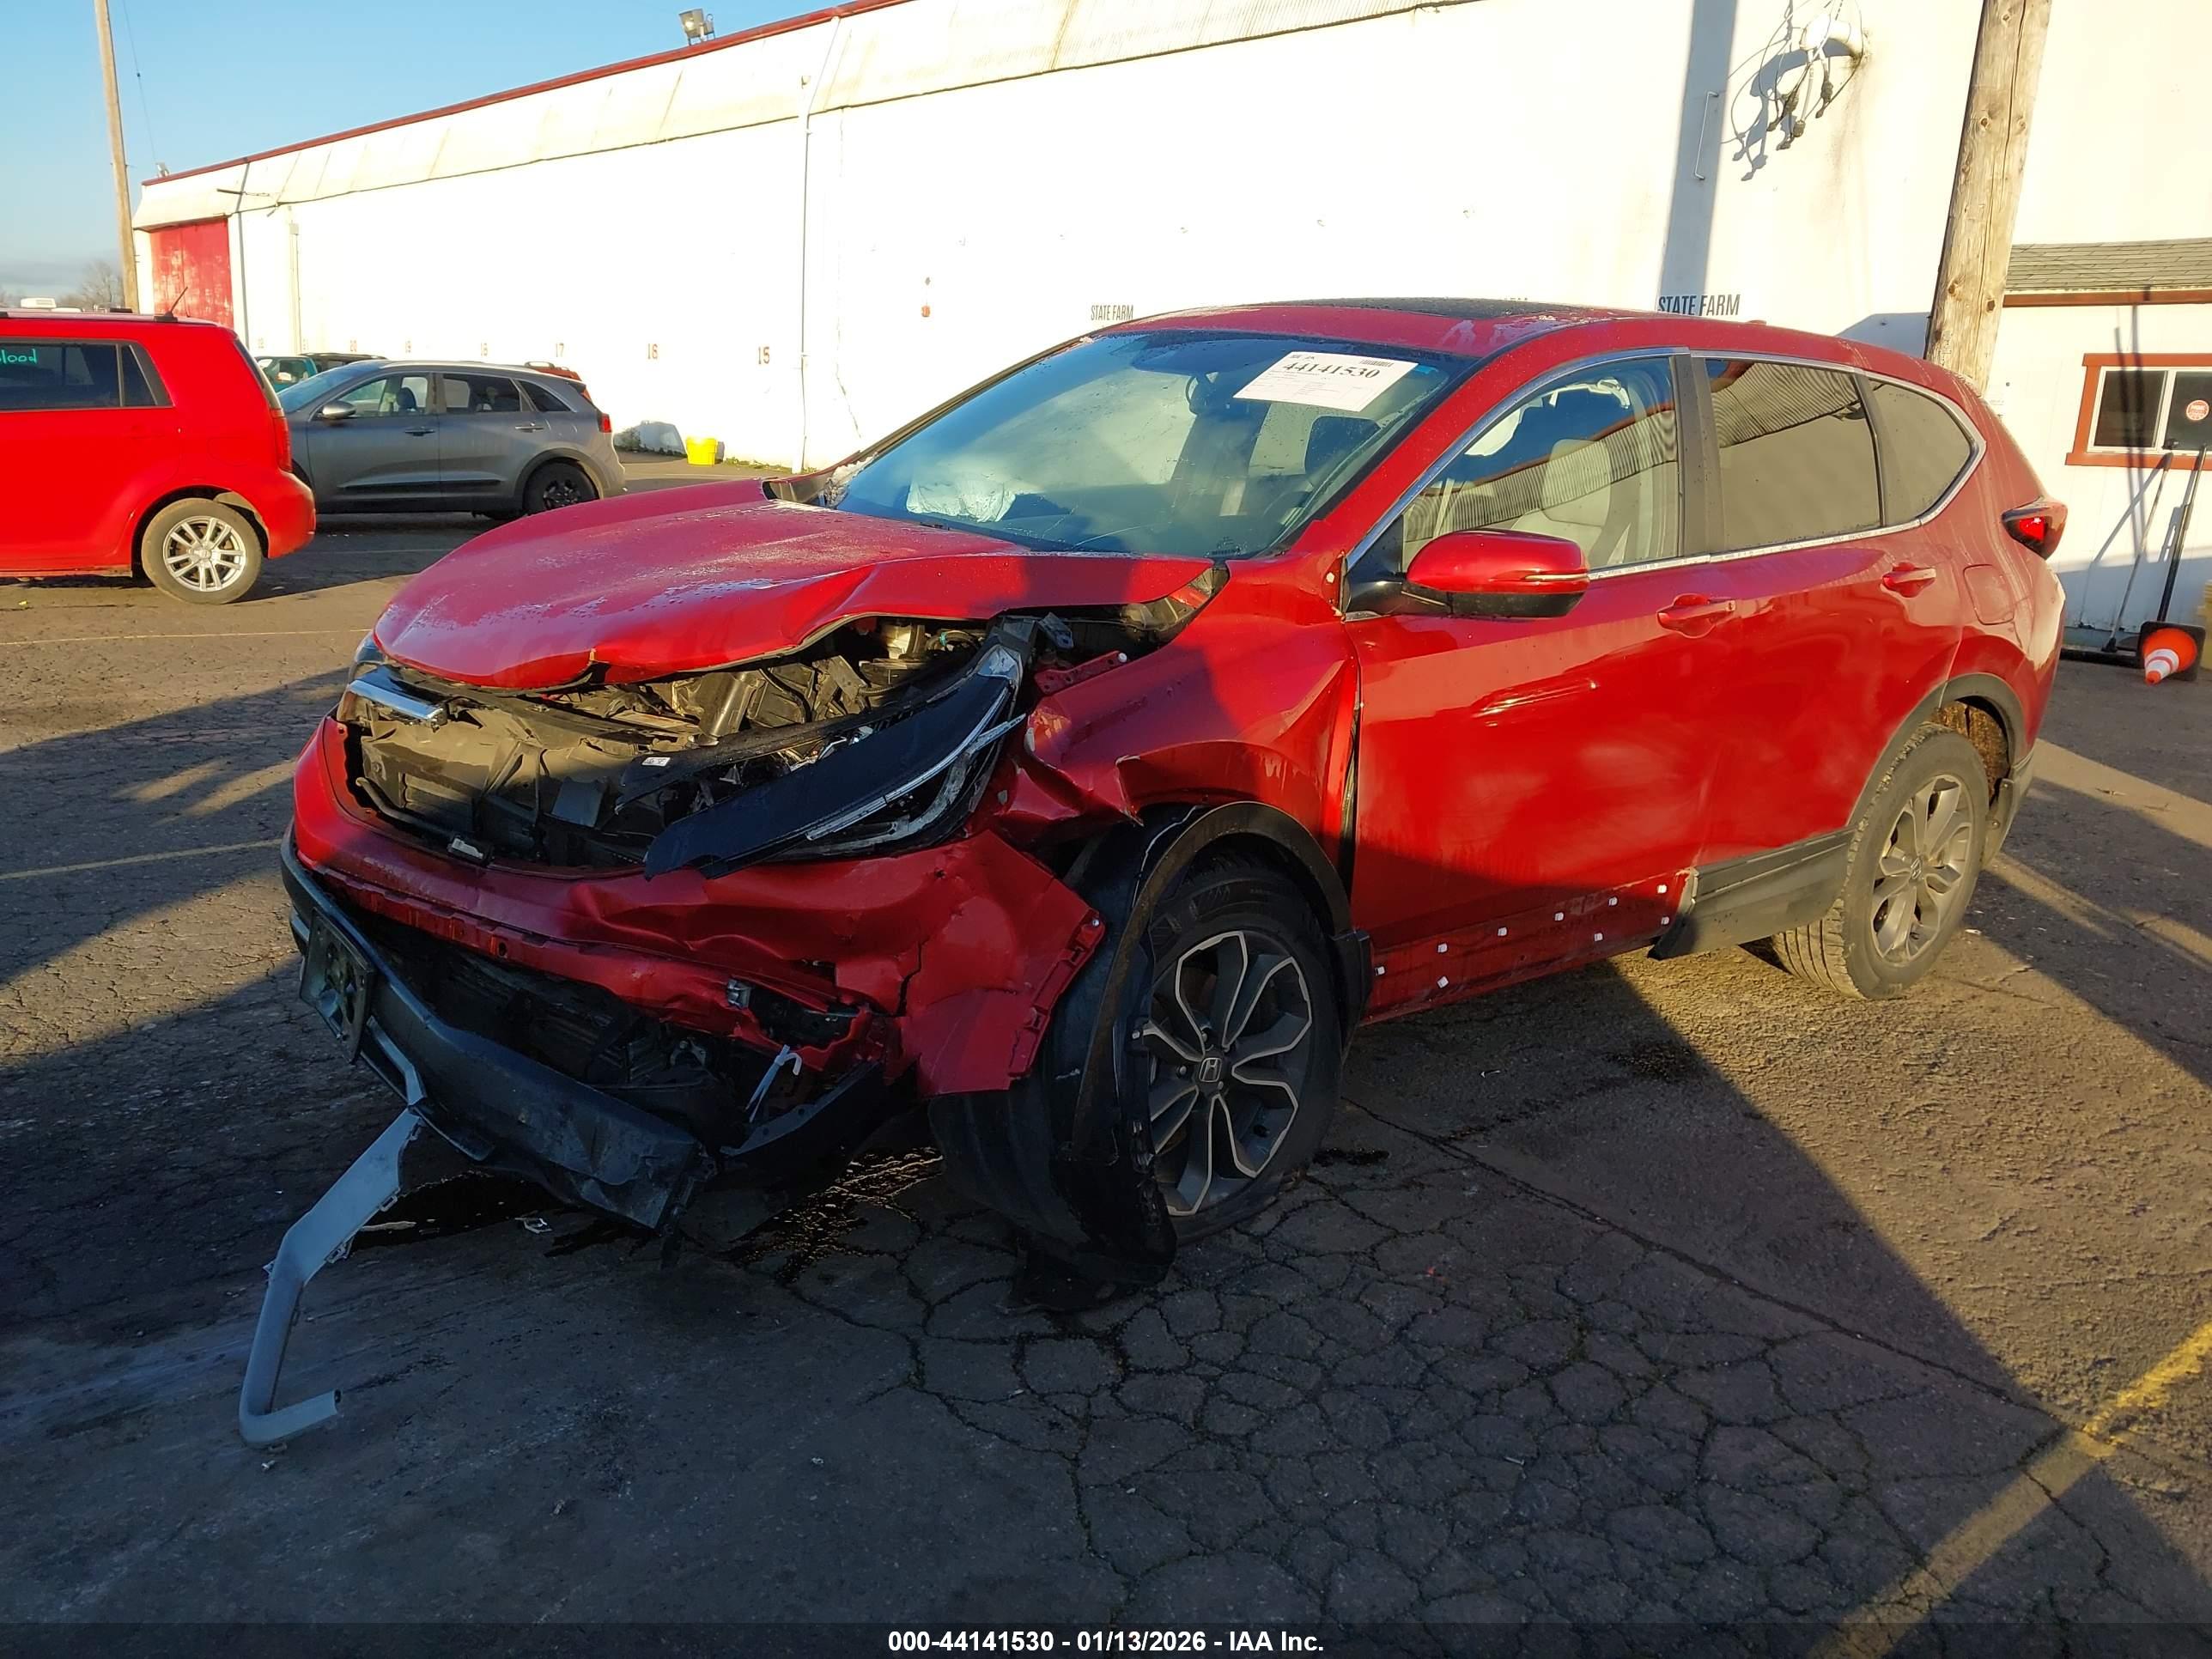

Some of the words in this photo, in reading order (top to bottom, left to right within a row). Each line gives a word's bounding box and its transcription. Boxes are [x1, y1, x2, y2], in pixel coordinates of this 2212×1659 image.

[1091, 304, 1111, 321] STATE
[1112, 304, 1133, 321] FARM
[1656, 295, 1697, 315] STATE
[1698, 294, 1741, 316] FARM
[0, 347, 37, 365] lood
[647, 343, 659, 360] 16
[757, 346, 771, 365] 15
[1282, 362, 1381, 379] 44141530
